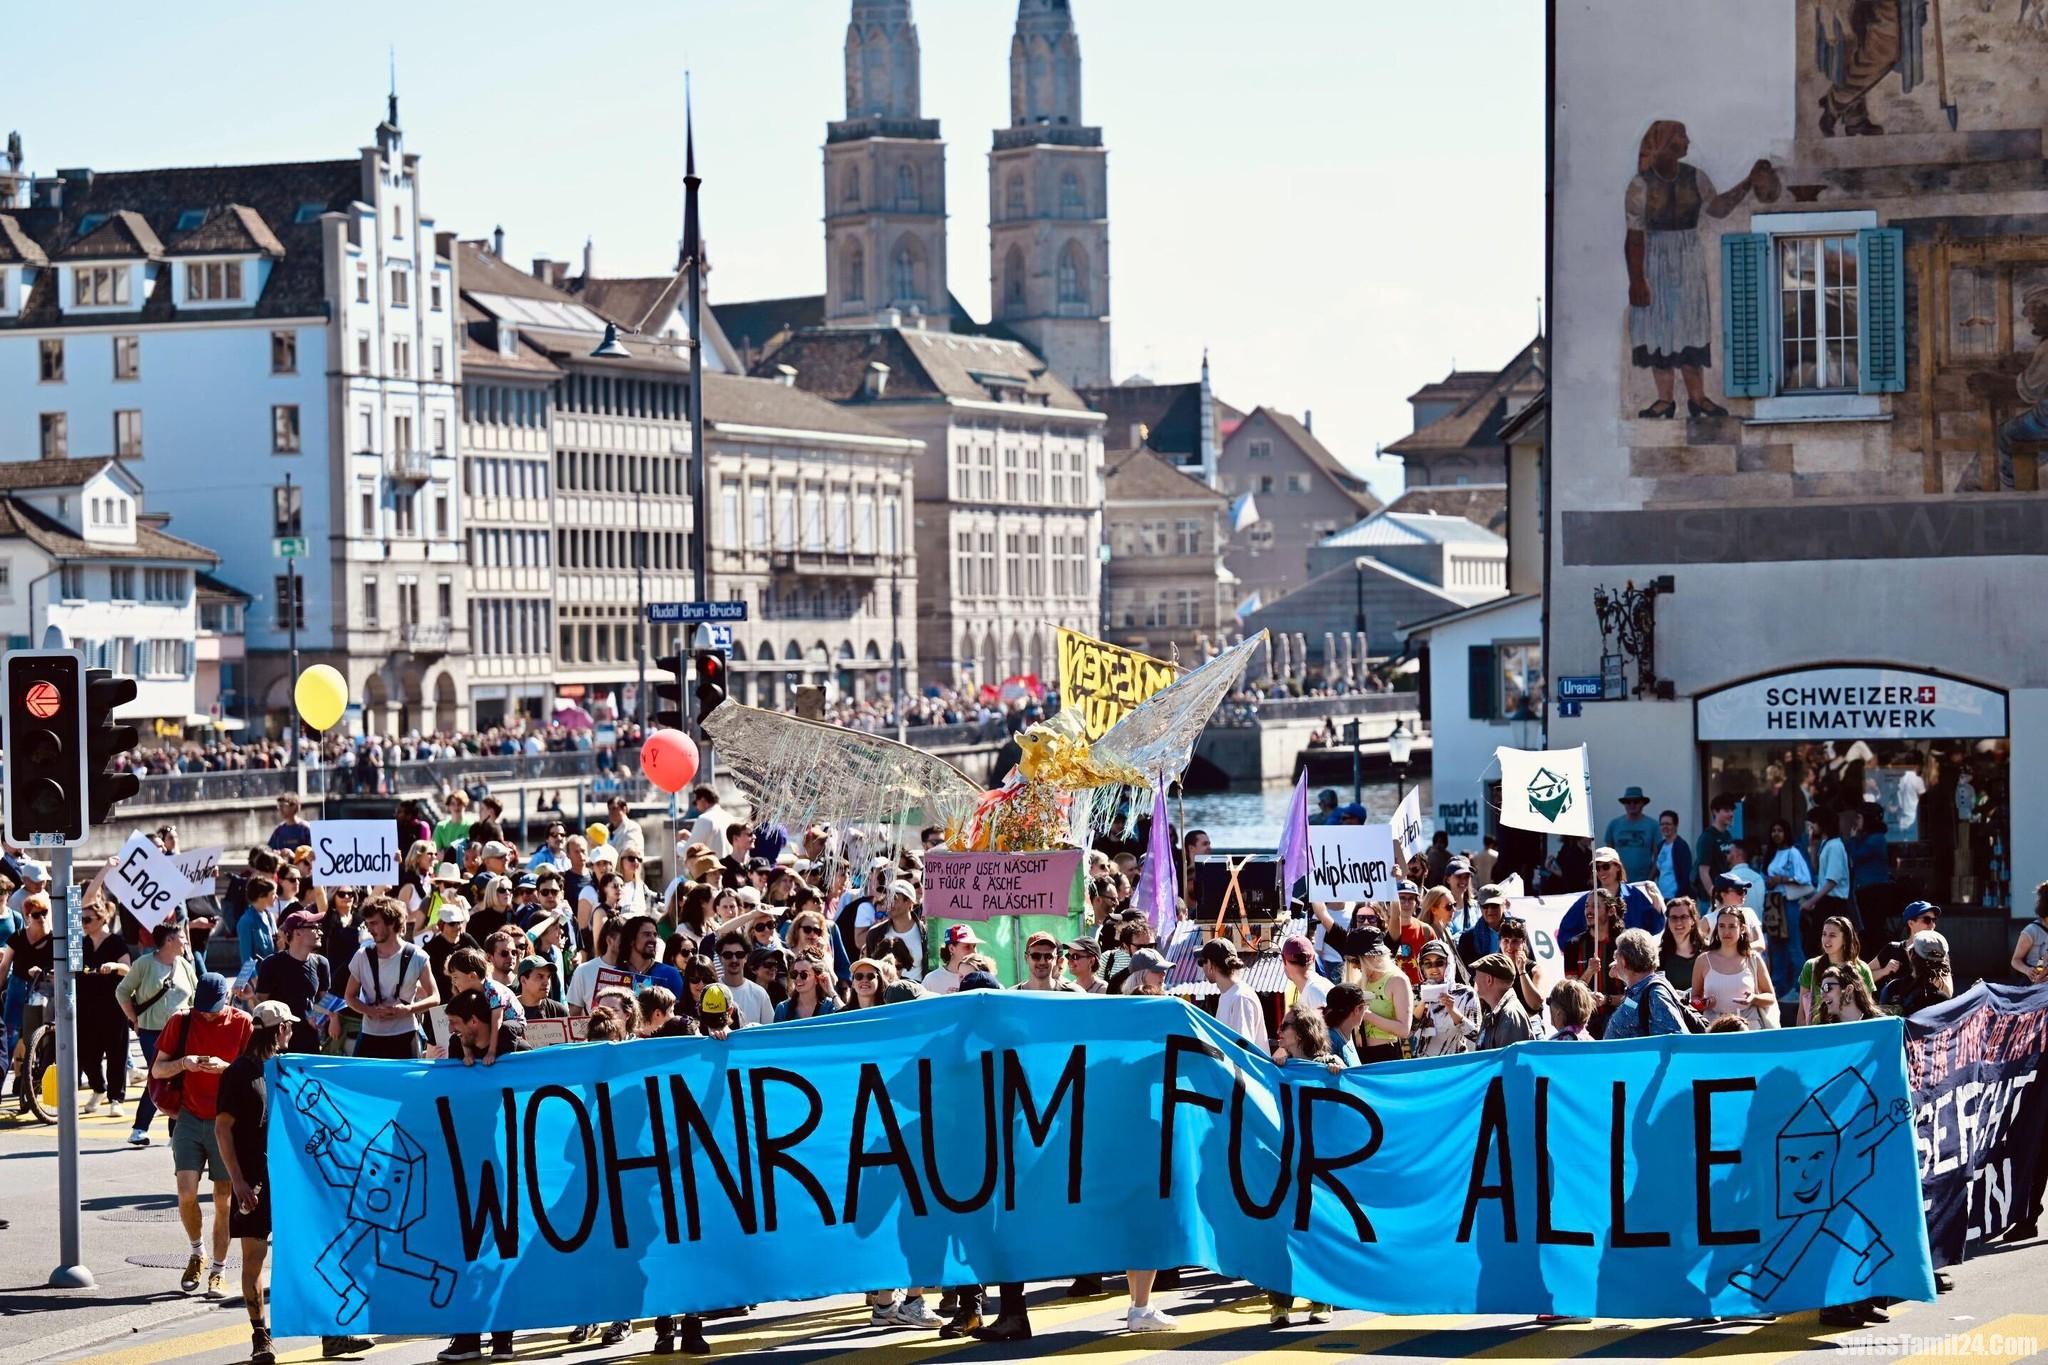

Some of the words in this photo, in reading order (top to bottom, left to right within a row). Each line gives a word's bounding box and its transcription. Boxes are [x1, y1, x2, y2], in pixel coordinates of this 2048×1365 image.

[652, 604, 679, 619] Rudolf
[1766, 686, 1912, 707] SCHWEIZER
[1567, 702, 1573, 715] 1
[1767, 709, 1936, 729] HEIMATWERK
[1438, 799, 1478, 817] markt
[319, 836, 391, 877] Seebach
[945, 861, 972, 875] HOPP
[976, 861, 1001, 876] USEM
[1004, 858, 1049, 874] NÄSCHT
[1309, 844, 1387, 898] Wipkingen
[118, 846, 171, 911] Enge
[939, 875, 966, 890] FÜÜR
[972, 875, 981, 891] &
[987, 876, 1022, 891] ÄSCHE
[950, 894, 973, 909] ALL
[436, 1044, 1087, 1262] WOHNRAUM
[1456, 1076, 1761, 1248] ALLE
